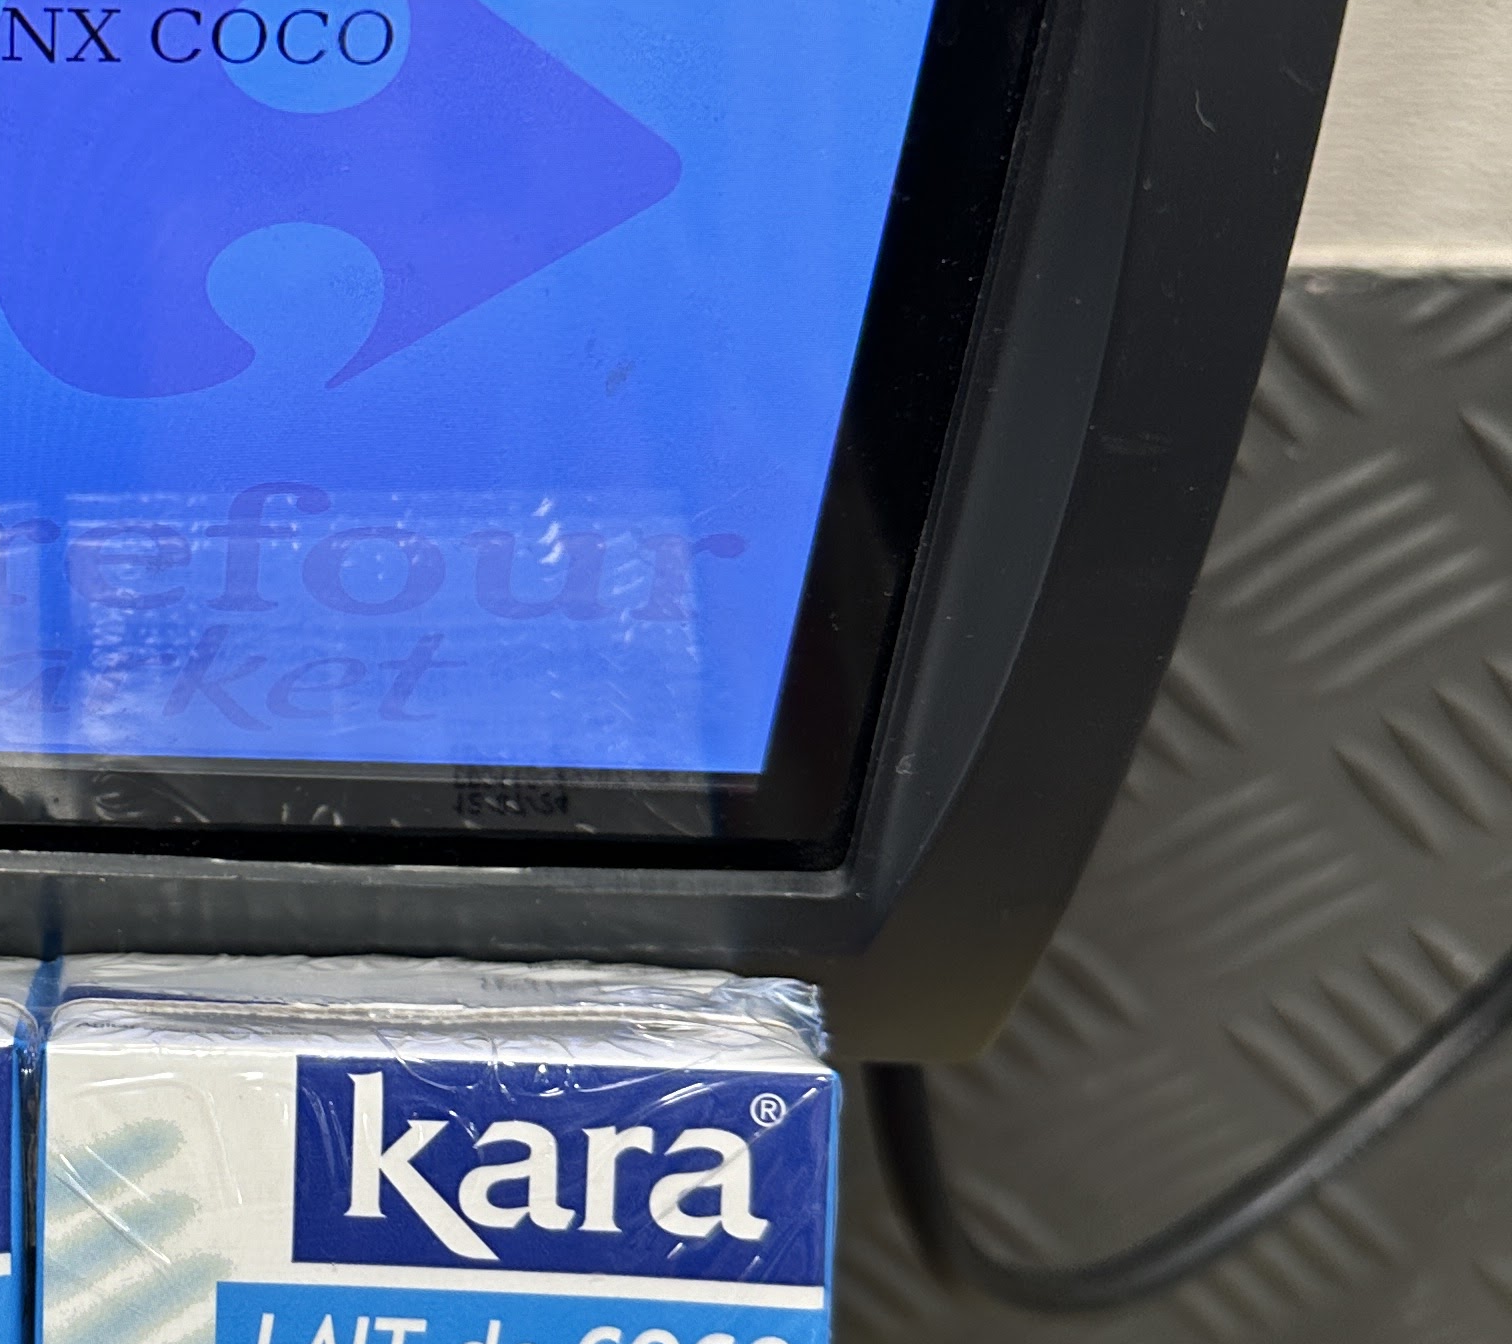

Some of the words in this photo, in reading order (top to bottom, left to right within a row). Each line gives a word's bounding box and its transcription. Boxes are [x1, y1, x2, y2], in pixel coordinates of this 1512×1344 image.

[2, 7, 121, 64] NX
[150, 7, 395, 66] COCO
[343, 1070, 773, 1261] kara
